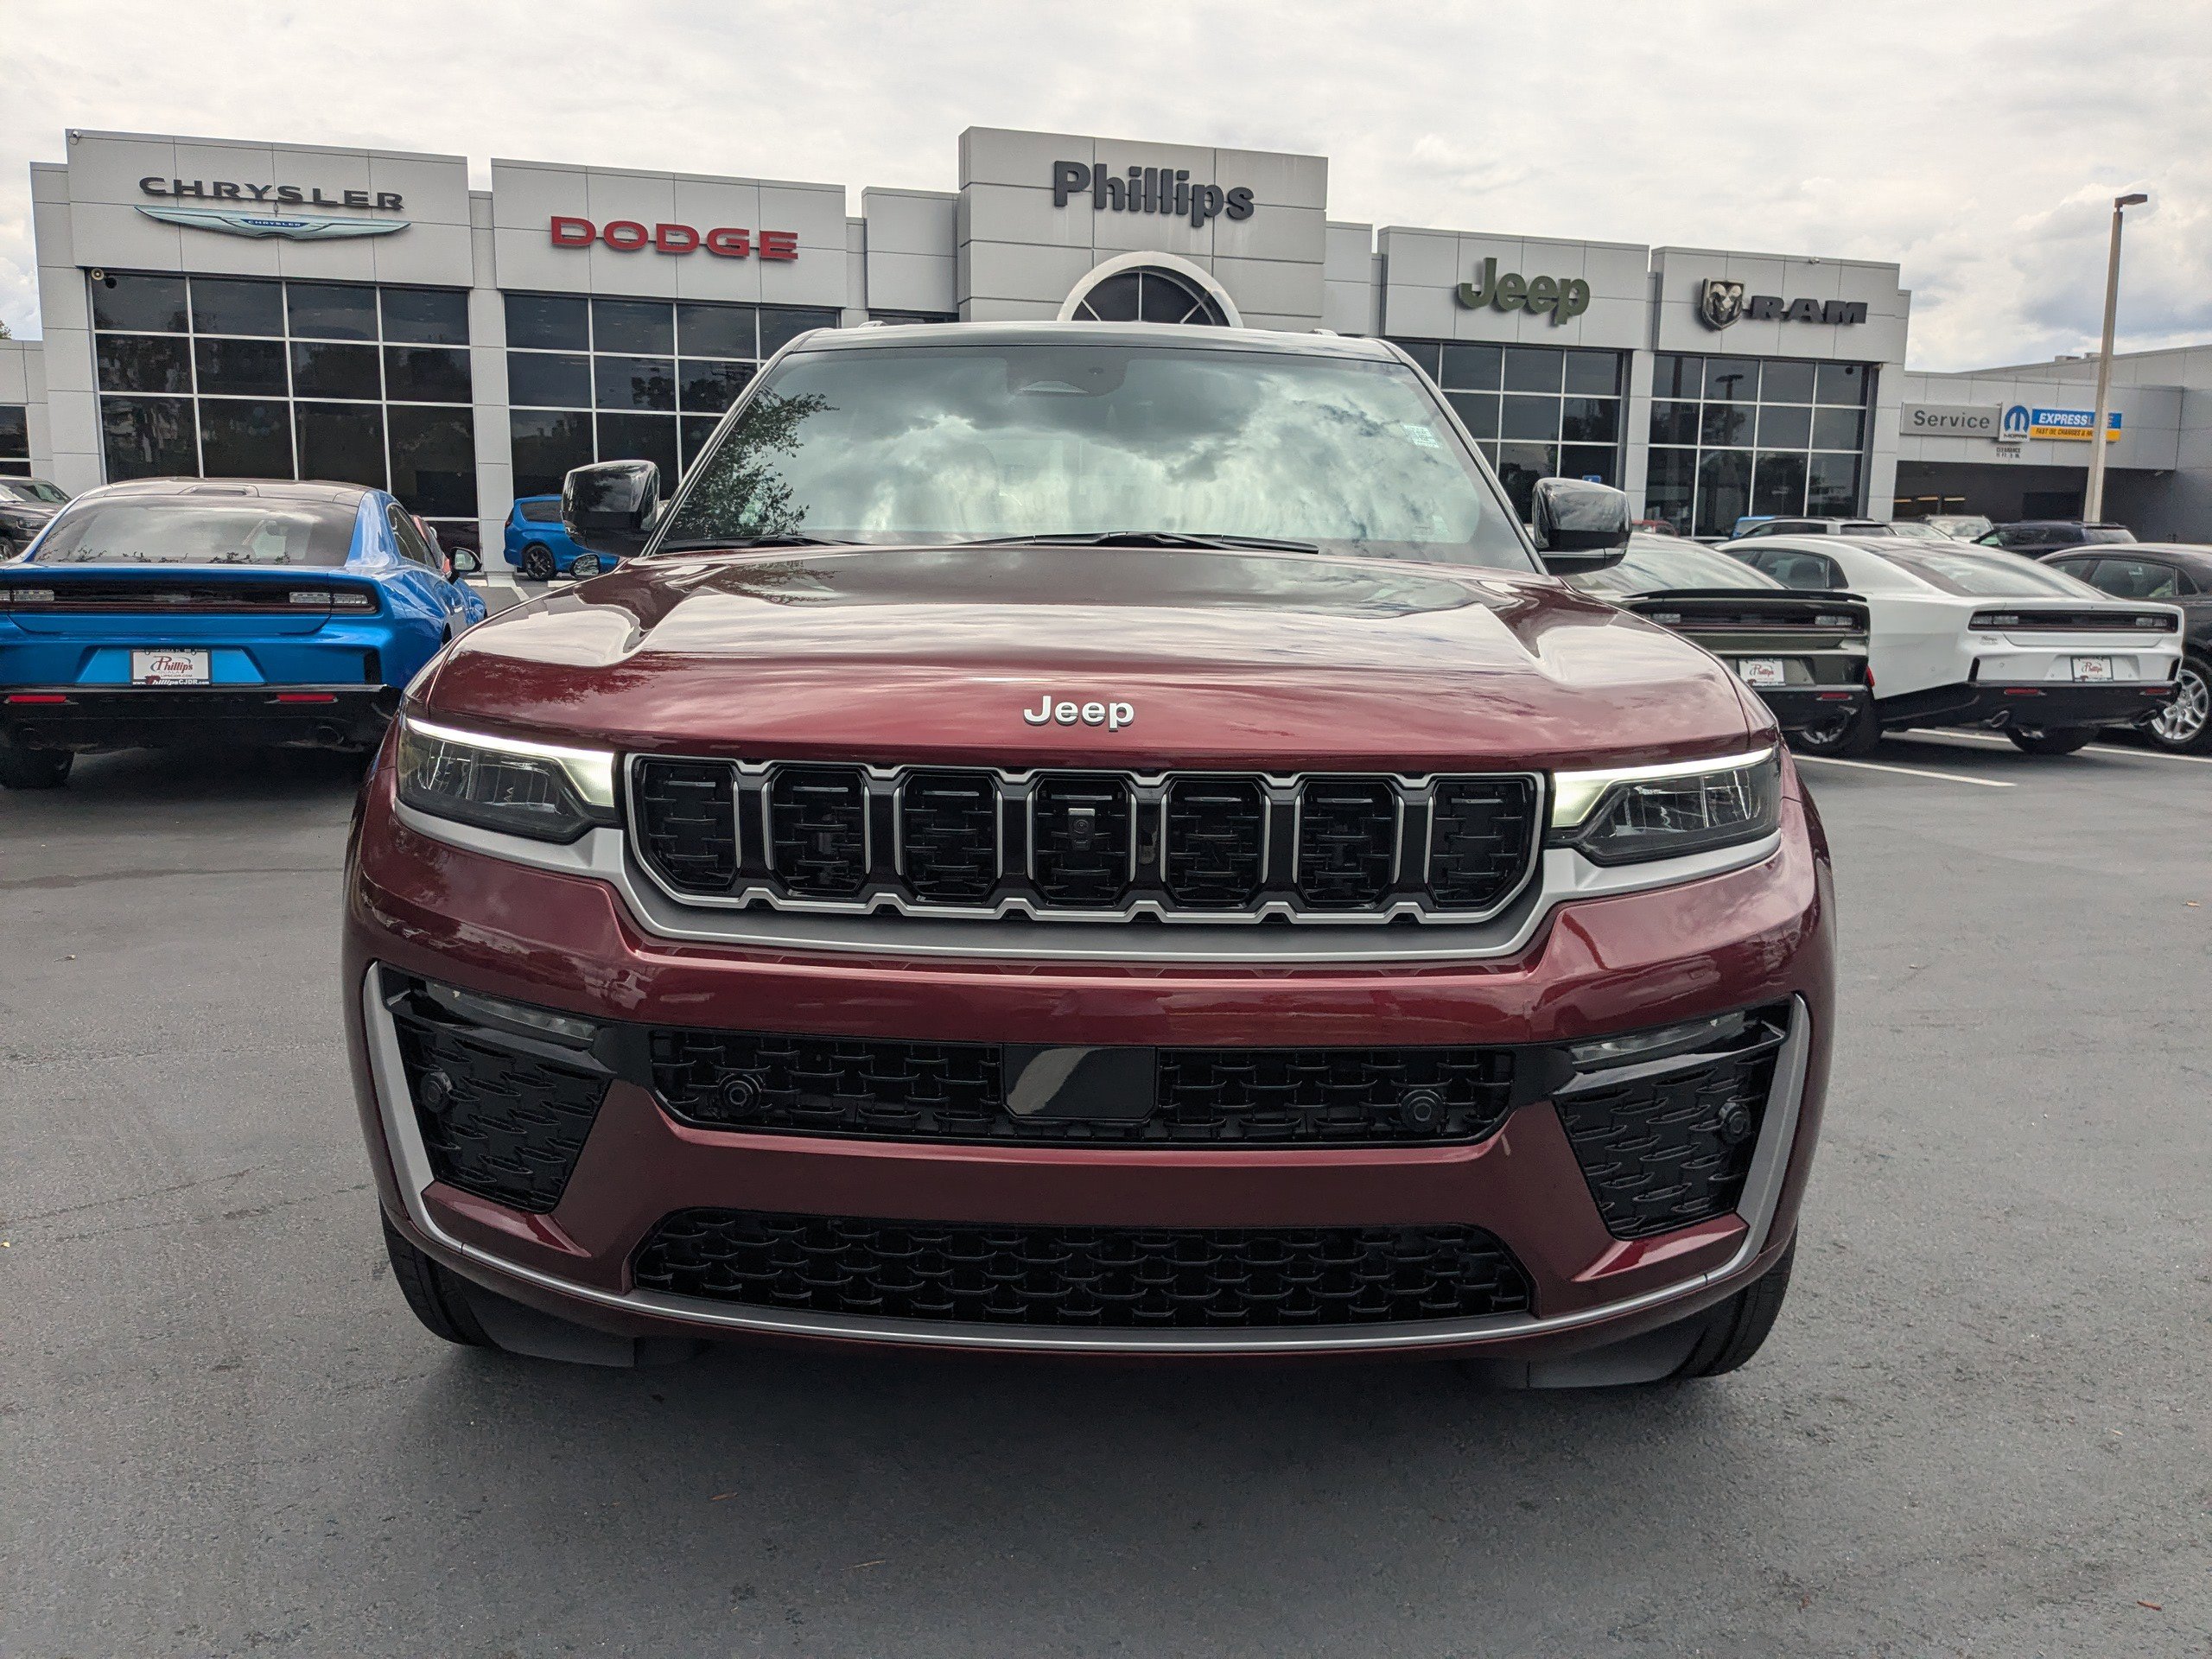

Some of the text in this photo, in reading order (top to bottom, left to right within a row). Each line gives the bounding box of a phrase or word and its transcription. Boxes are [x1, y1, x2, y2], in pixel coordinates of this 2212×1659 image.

[139, 176, 404, 210] CHRYSLER
[1054, 160, 1254, 227] Phillips
[551, 216, 798, 259] DODGE
[1458, 257, 1591, 326] Jeep
[1751, 295, 1868, 324] RAM
[1913, 410, 1990, 429] Service
[153, 656, 193, 673] Phillips
[1024, 696, 1134, 732] Jeep
